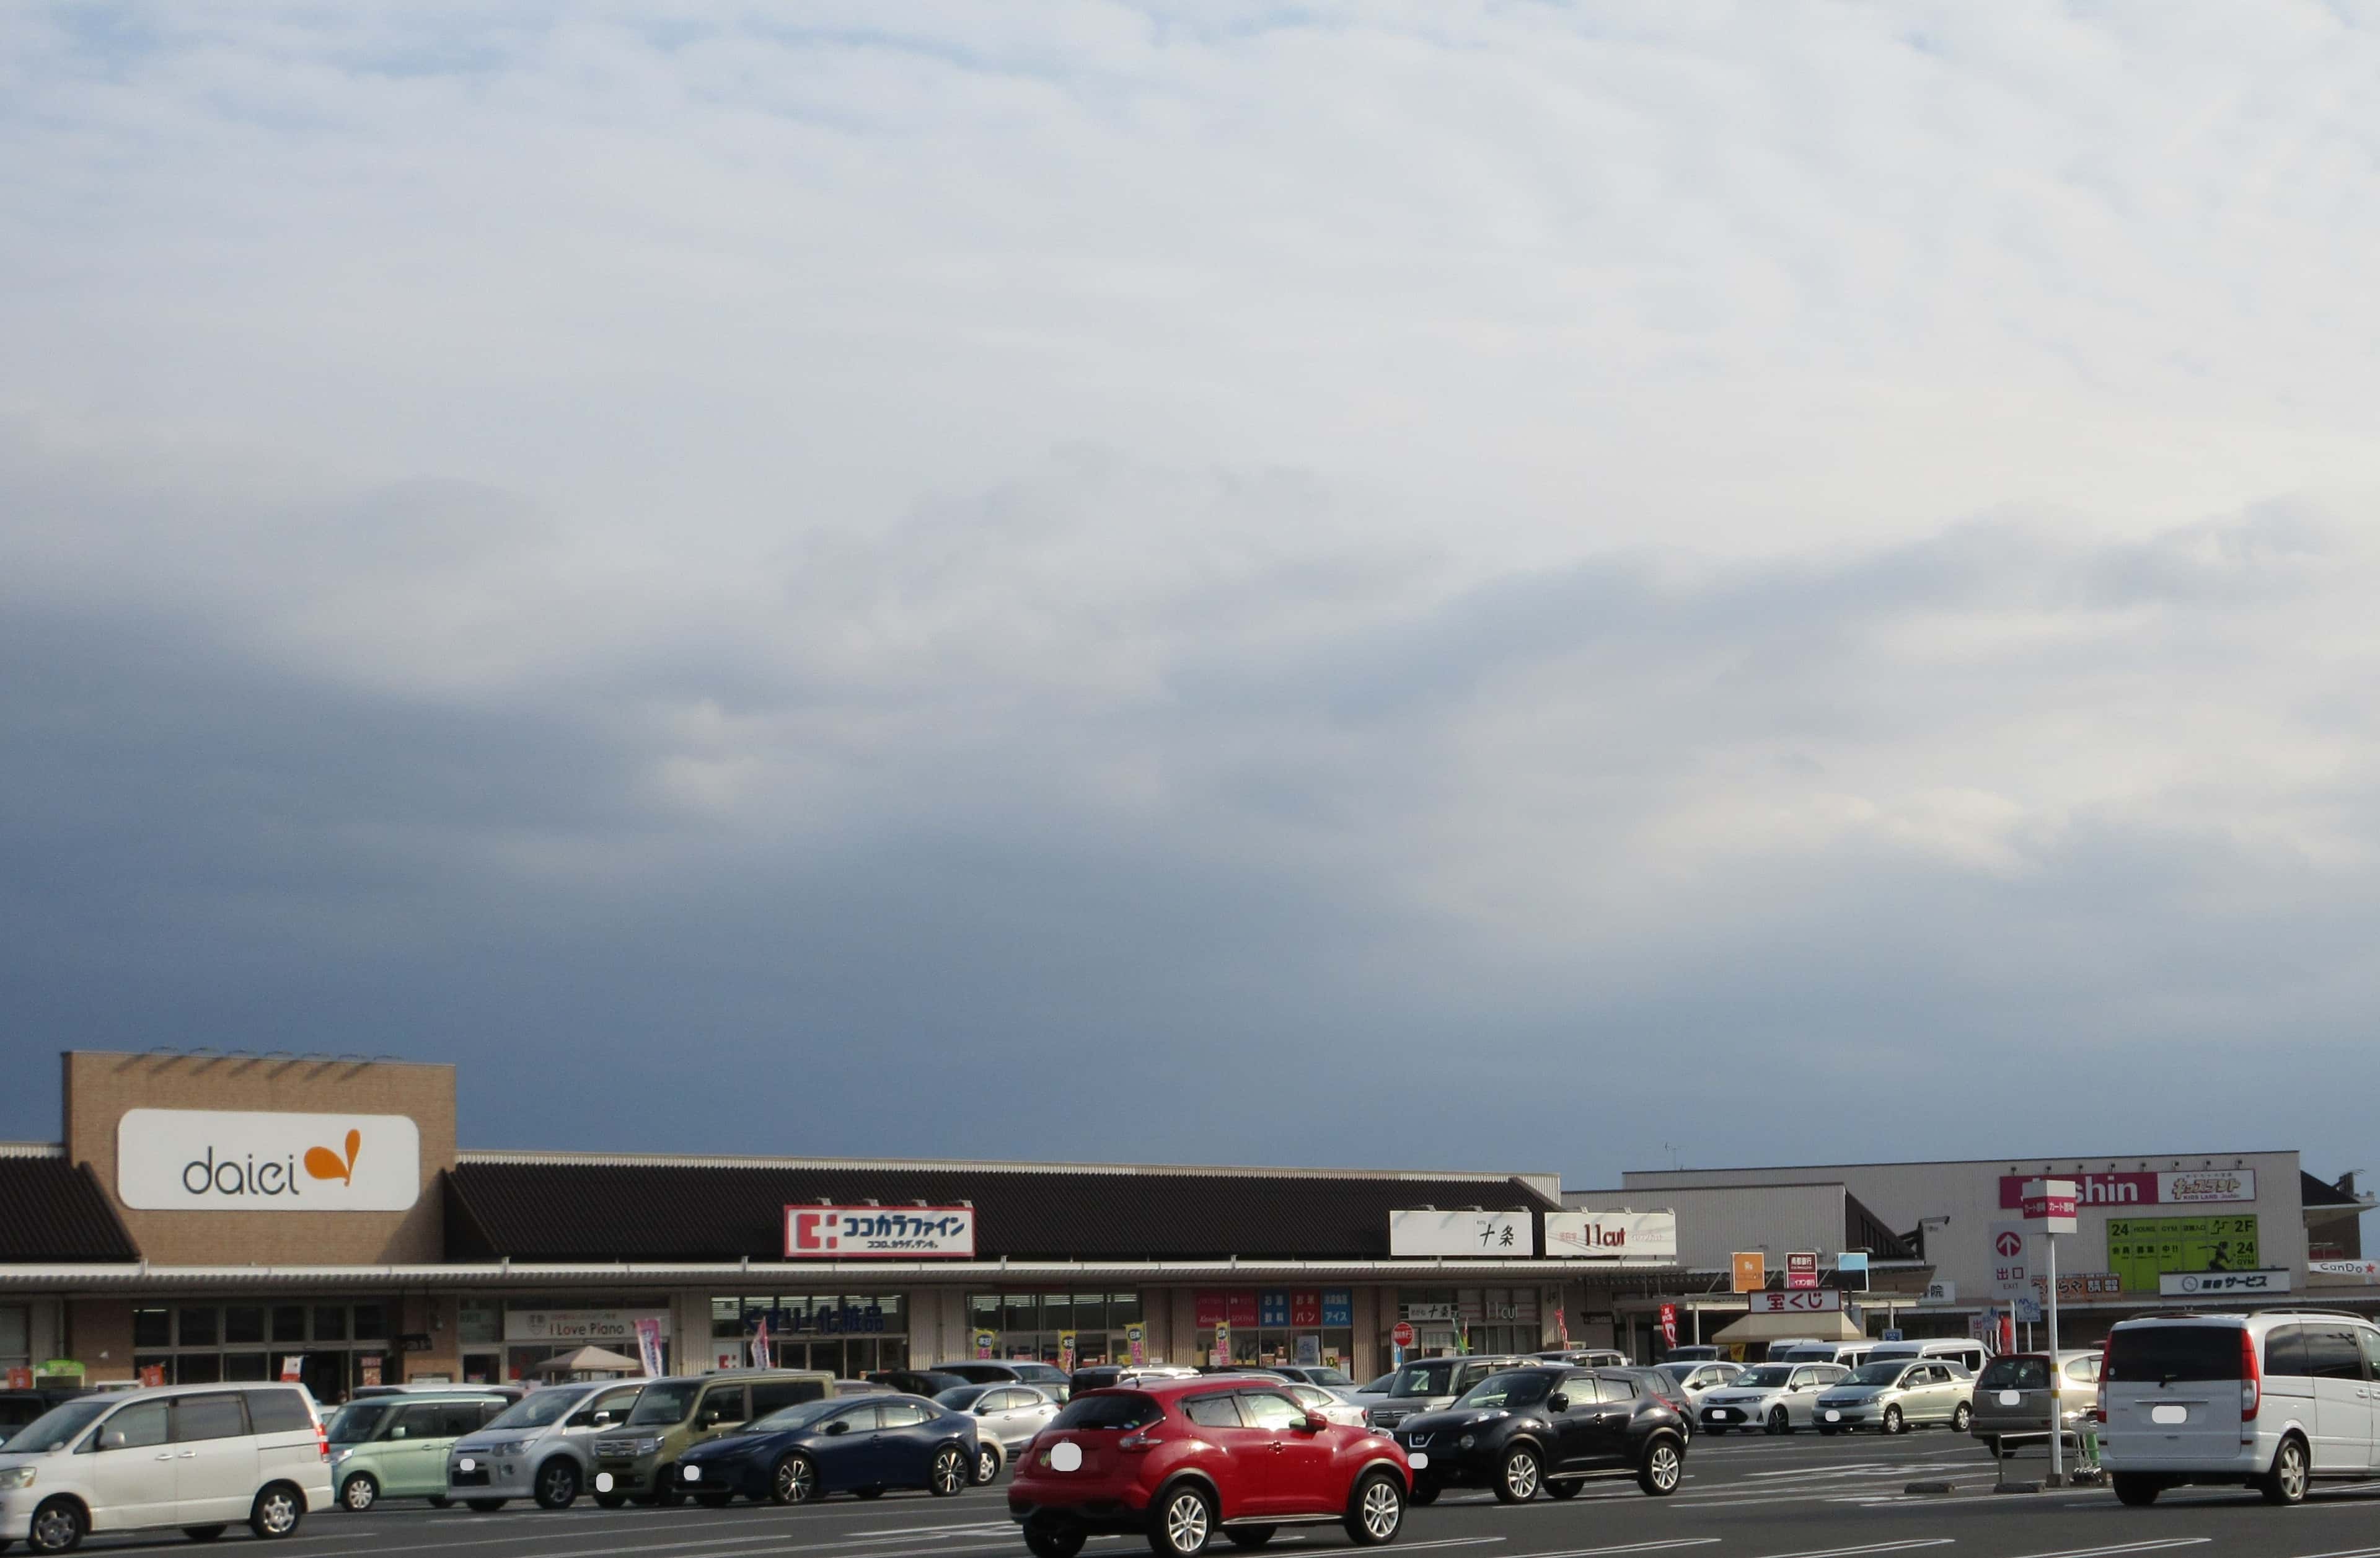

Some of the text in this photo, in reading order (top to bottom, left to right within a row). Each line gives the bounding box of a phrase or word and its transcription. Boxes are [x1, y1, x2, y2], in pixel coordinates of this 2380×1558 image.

[183, 1146, 300, 1196] daiei
[843, 1215, 965, 1237] ココカラファイン
[2112, 1223, 2129, 1236] 24
[2234, 1219, 2254, 1233] 2F
[1479, 1224, 1514, 1247] 十条
[2237, 1242, 2254, 1254] 24
[1997, 1267, 2024, 1280] 出口
[1767, 1291, 1823, 1310] 宝くじ
[1296, 1311, 1315, 1322] パン
[1324, 1311, 1347, 1322] アイス
[557, 1323, 586, 1335] Love
[590, 1322, 625, 1335] Piano
